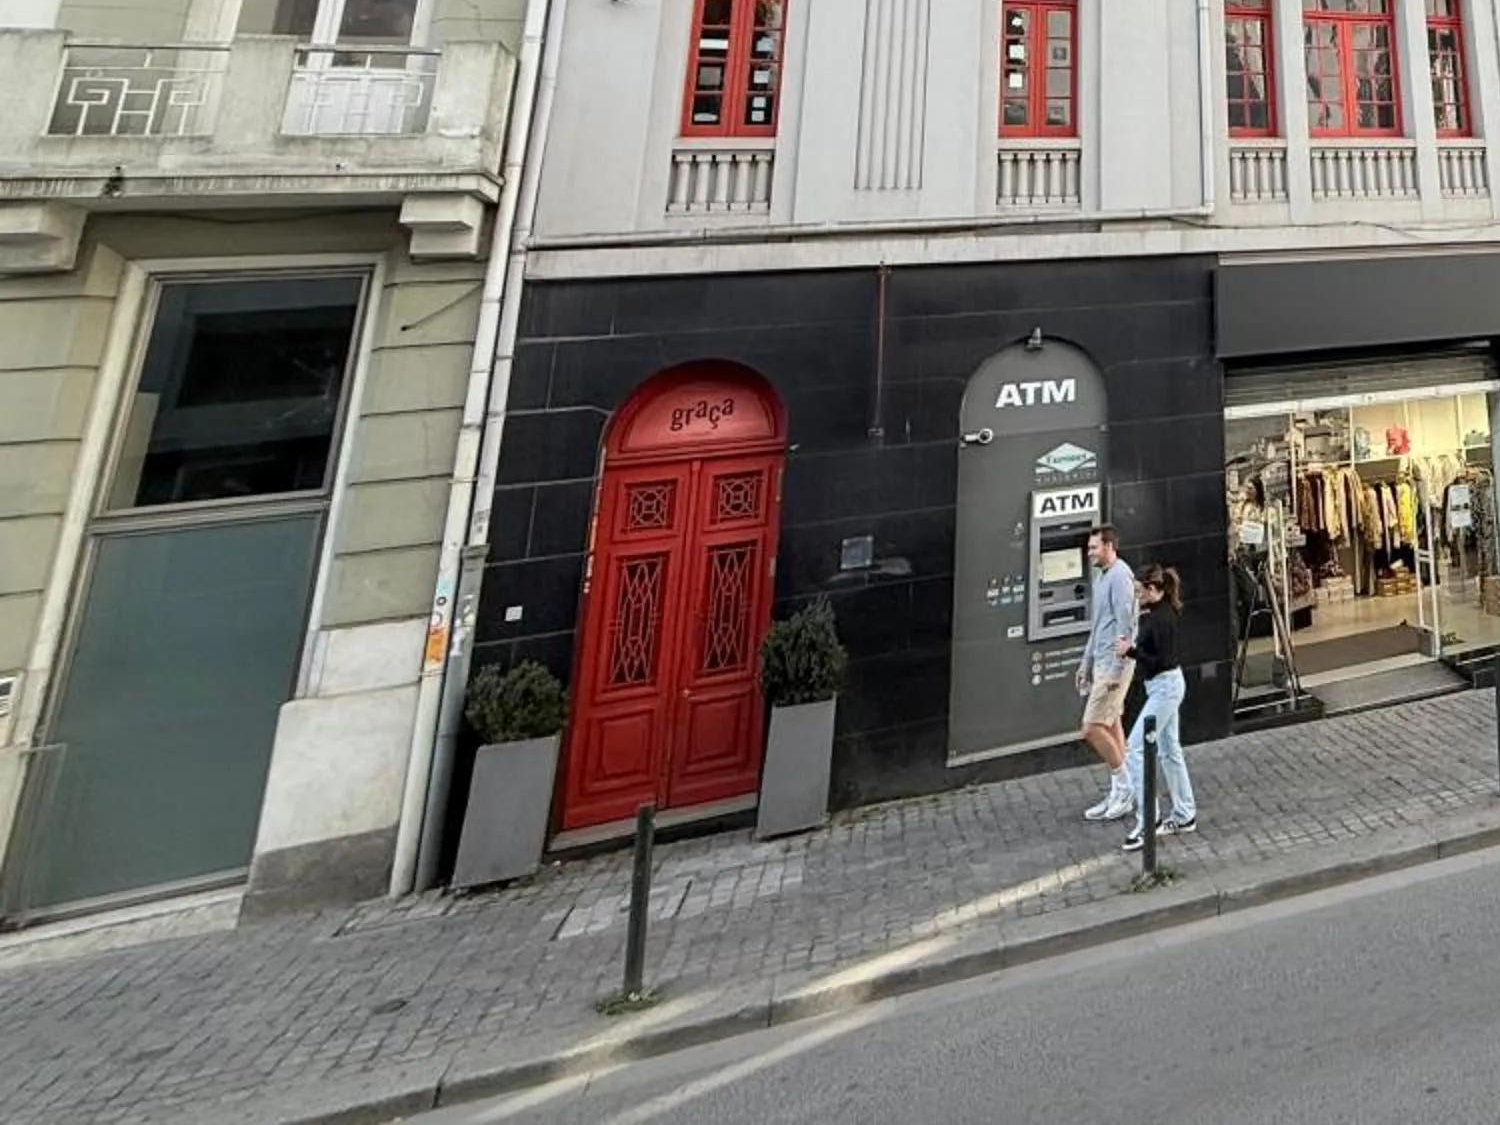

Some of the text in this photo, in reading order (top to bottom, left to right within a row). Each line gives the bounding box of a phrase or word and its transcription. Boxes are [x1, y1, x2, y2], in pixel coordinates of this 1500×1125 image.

[995, 378, 1076, 408] ATM
[670, 398, 735, 432] graça
[1040, 492, 1095, 514] ATM
